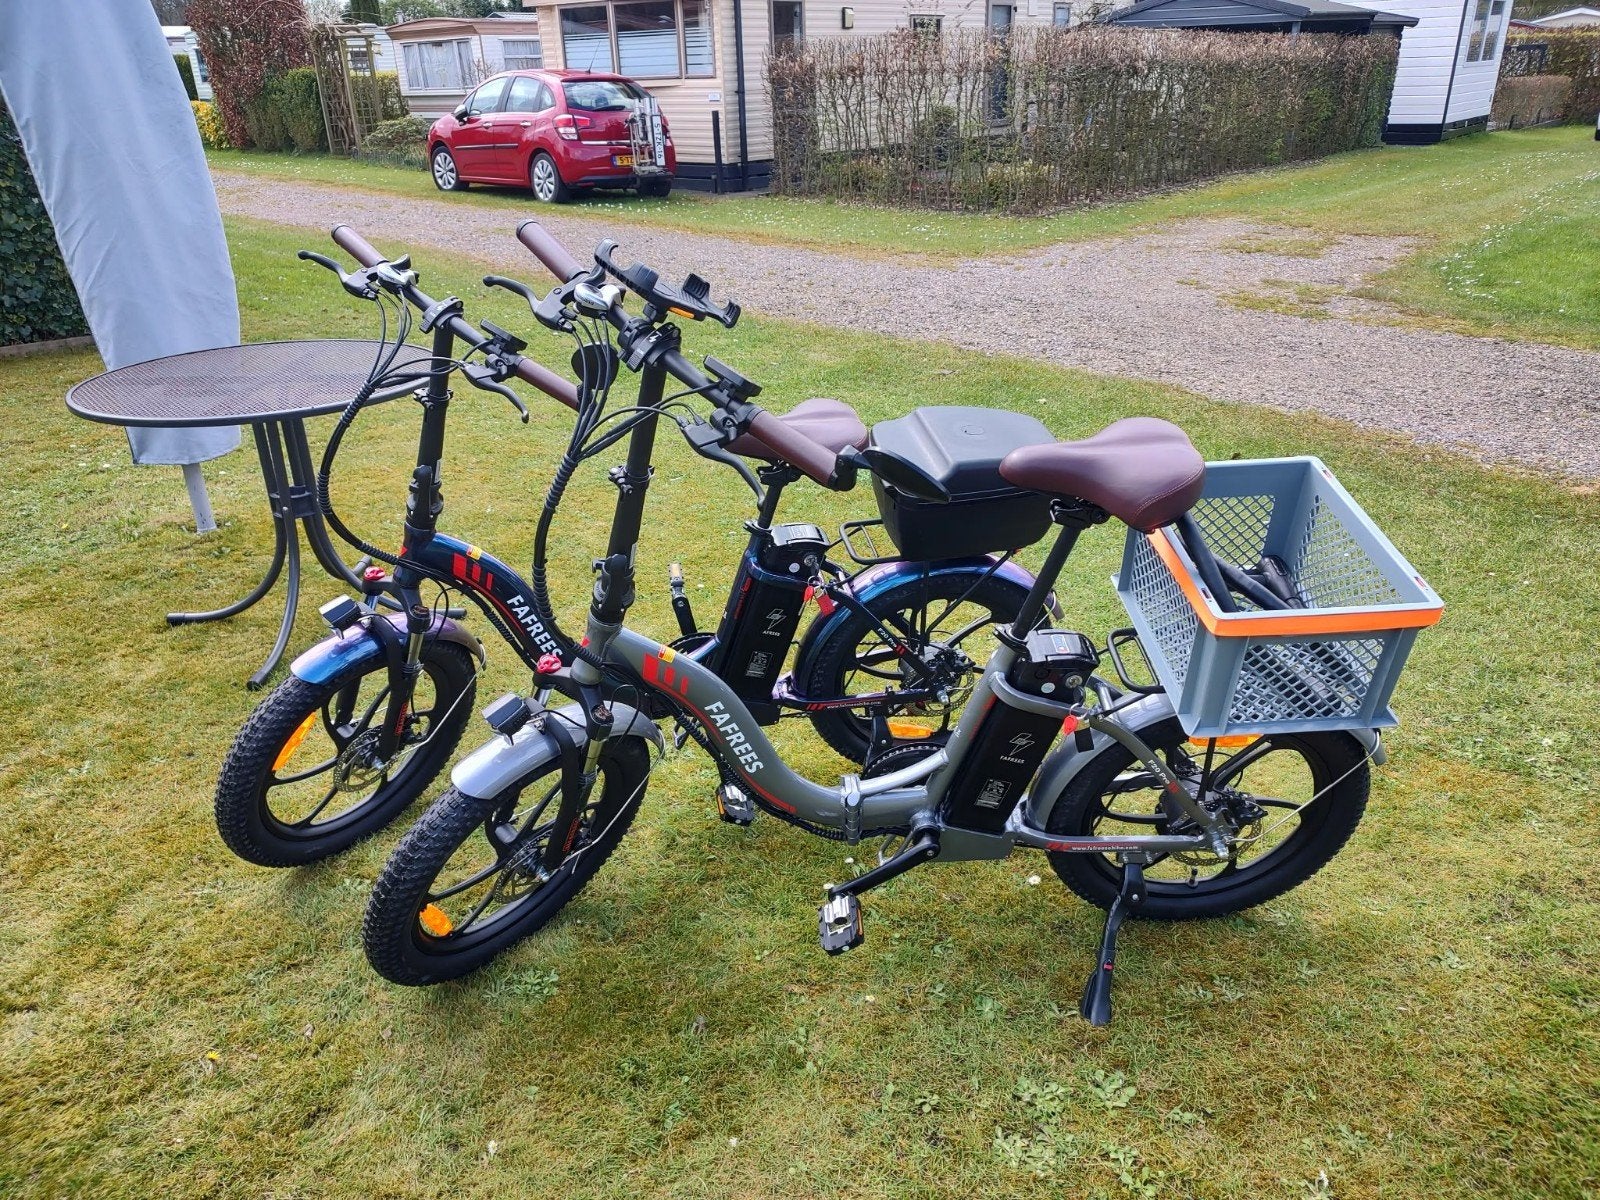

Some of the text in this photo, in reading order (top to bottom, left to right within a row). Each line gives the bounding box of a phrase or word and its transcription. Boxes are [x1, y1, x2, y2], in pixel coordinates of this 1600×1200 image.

[704, 701, 764, 773] FAFREES
[1148, 760, 1170, 784] F20 Pro
